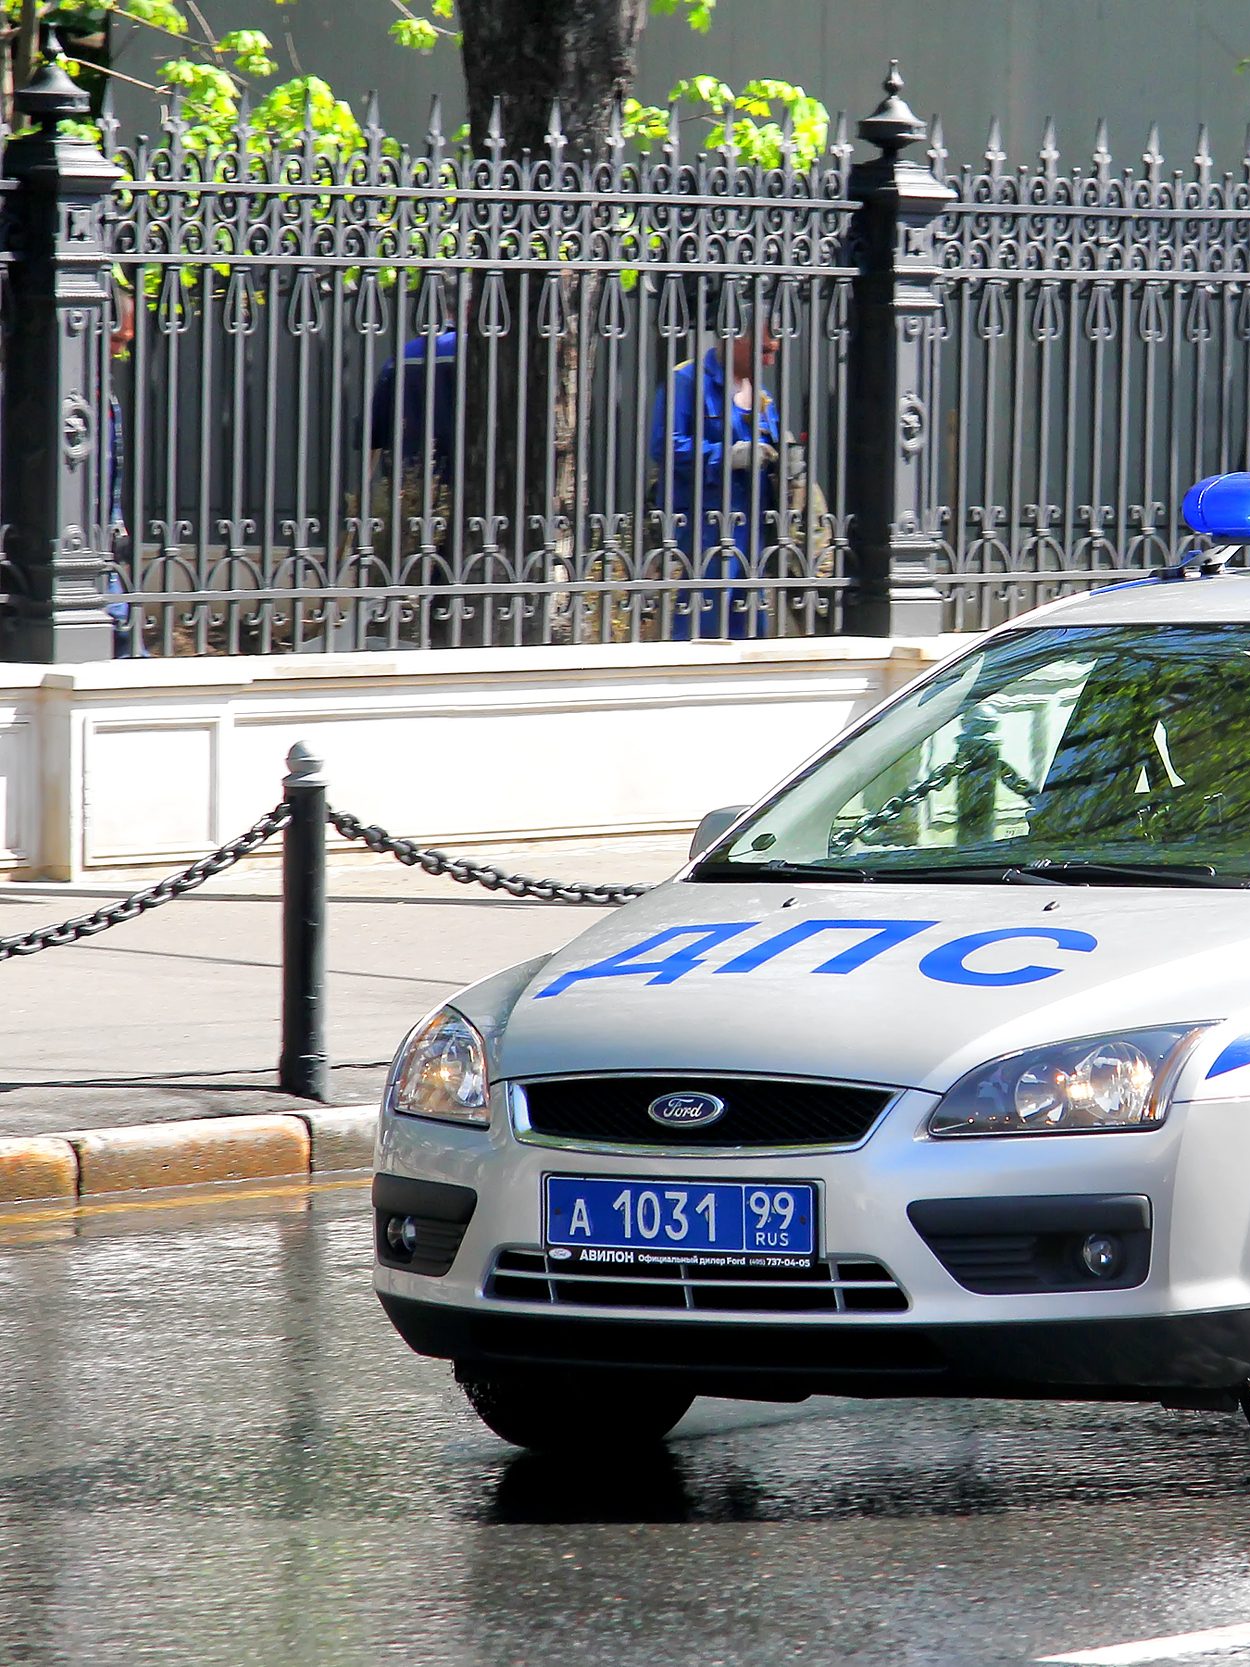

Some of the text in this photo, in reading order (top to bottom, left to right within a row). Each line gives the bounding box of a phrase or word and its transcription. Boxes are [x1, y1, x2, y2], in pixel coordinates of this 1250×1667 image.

[532, 919, 1099, 1000] ДПС
[663, 1098, 704, 1118] Ford
[612, 1189, 717, 1243] 1031
[750, 1191, 795, 1230] 99
[755, 1232, 790, 1247] RUS
[579, 1249, 634, 1263] АВИЛОН
[699, 1257, 725, 1266] дилер
[726, 1257, 746, 1266] Ford
